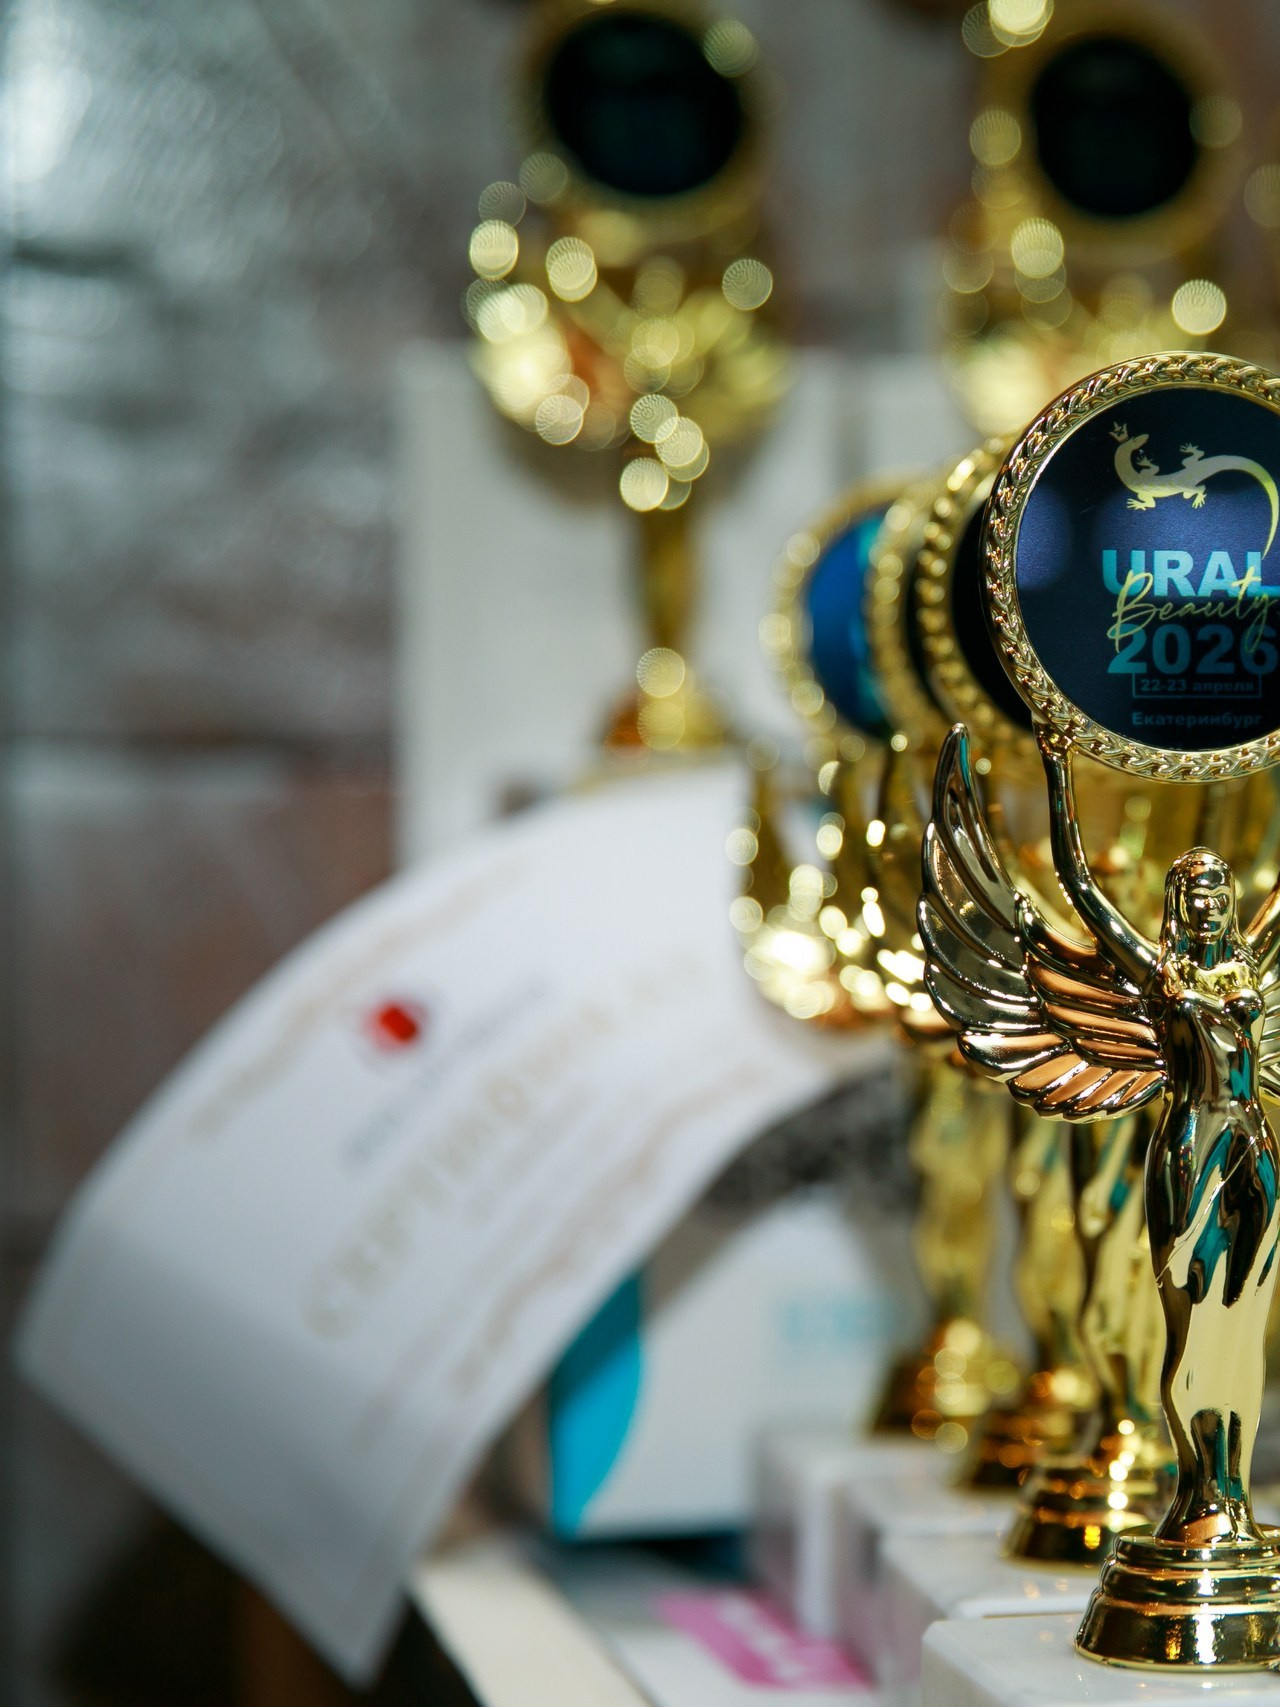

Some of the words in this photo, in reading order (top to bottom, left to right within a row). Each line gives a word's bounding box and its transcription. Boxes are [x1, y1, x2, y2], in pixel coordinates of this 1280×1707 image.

[1107, 566, 1279, 653] Beauty
[1107, 624, 1279, 675] 2026
[1140, 678, 1187, 692] 22-23
[1193, 682, 1255, 695] апреля
[1132, 711, 1262, 729] Екатеринбург
